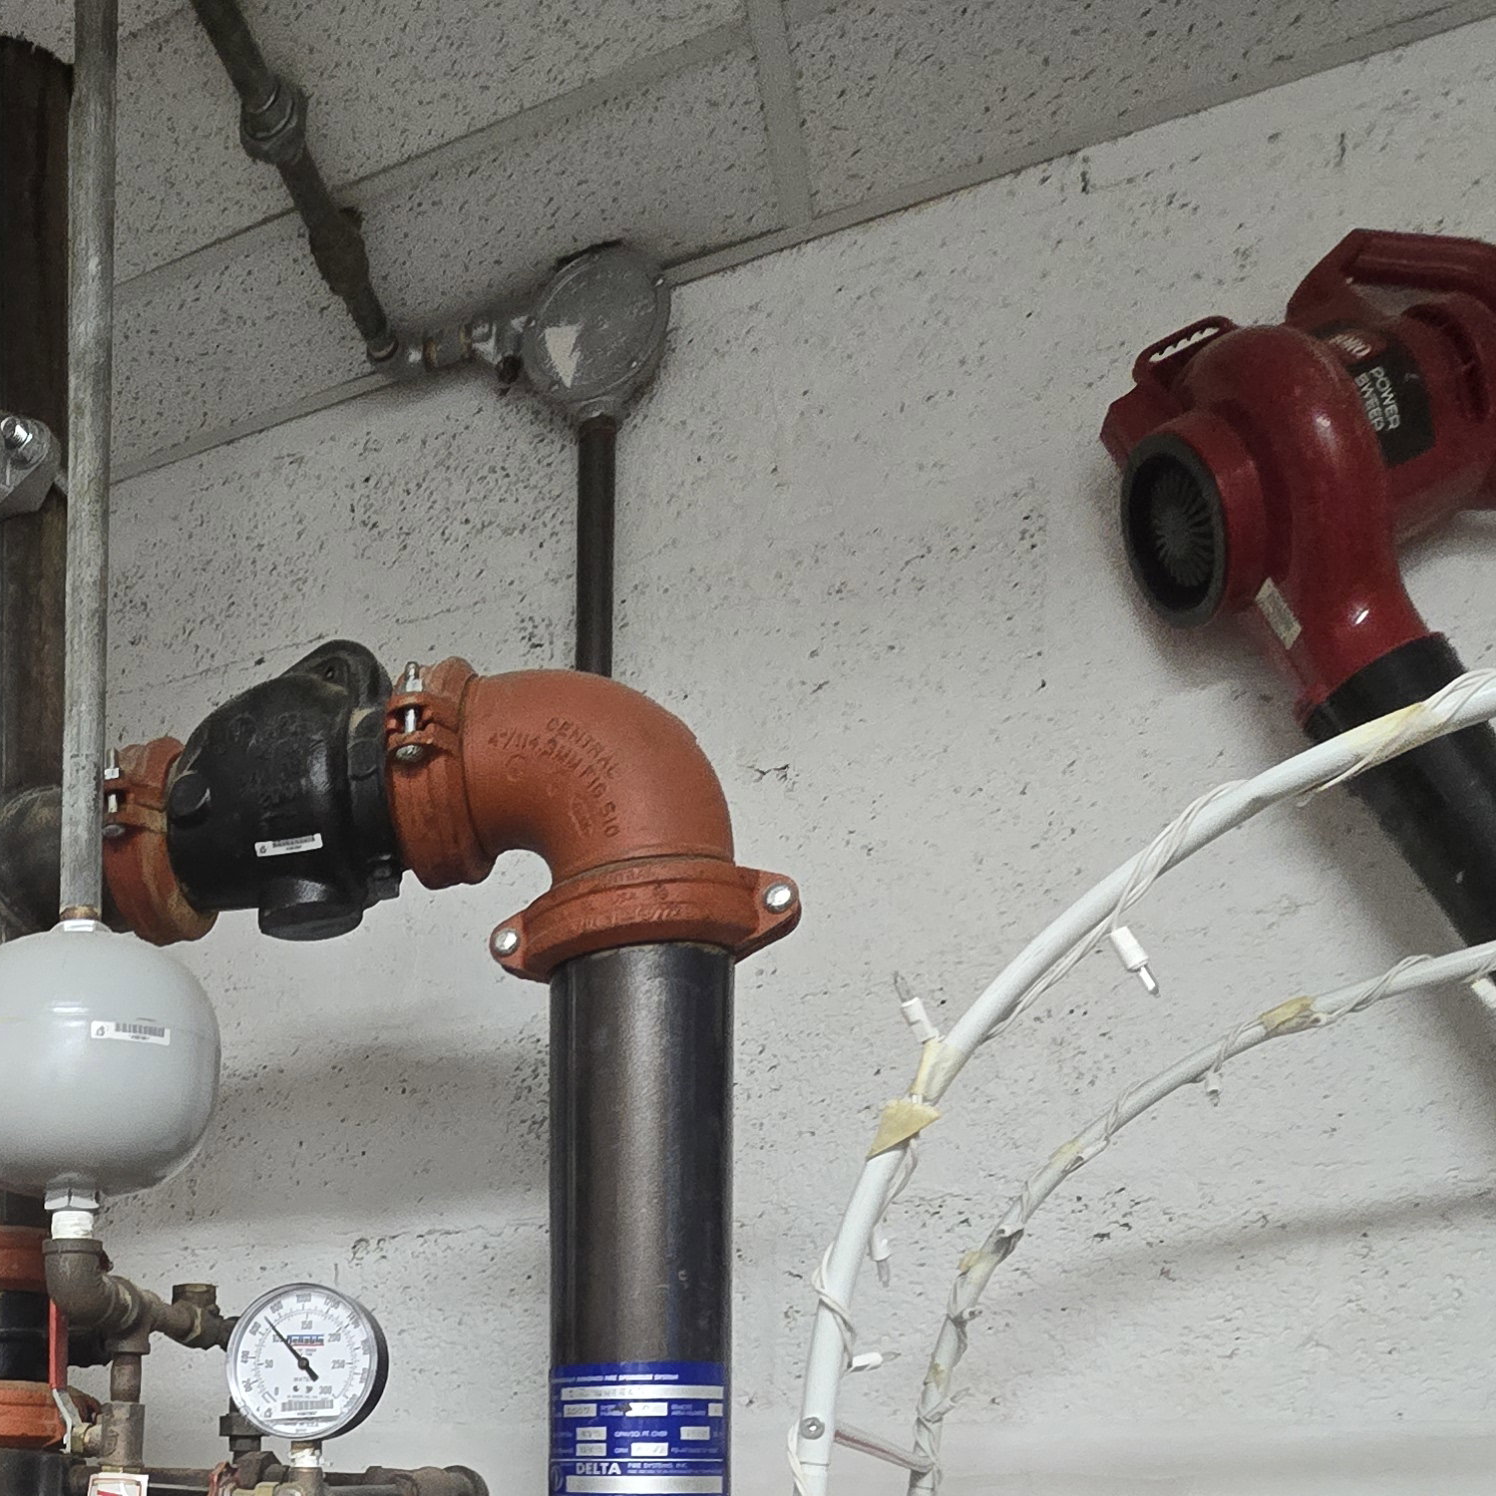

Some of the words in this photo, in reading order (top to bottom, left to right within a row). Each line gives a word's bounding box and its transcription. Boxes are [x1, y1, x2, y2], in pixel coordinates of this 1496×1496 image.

[1369, 366, 1400, 431] POWER
[331, 1359, 345, 1370] 250
[575, 1462, 622, 1475] DELTA
